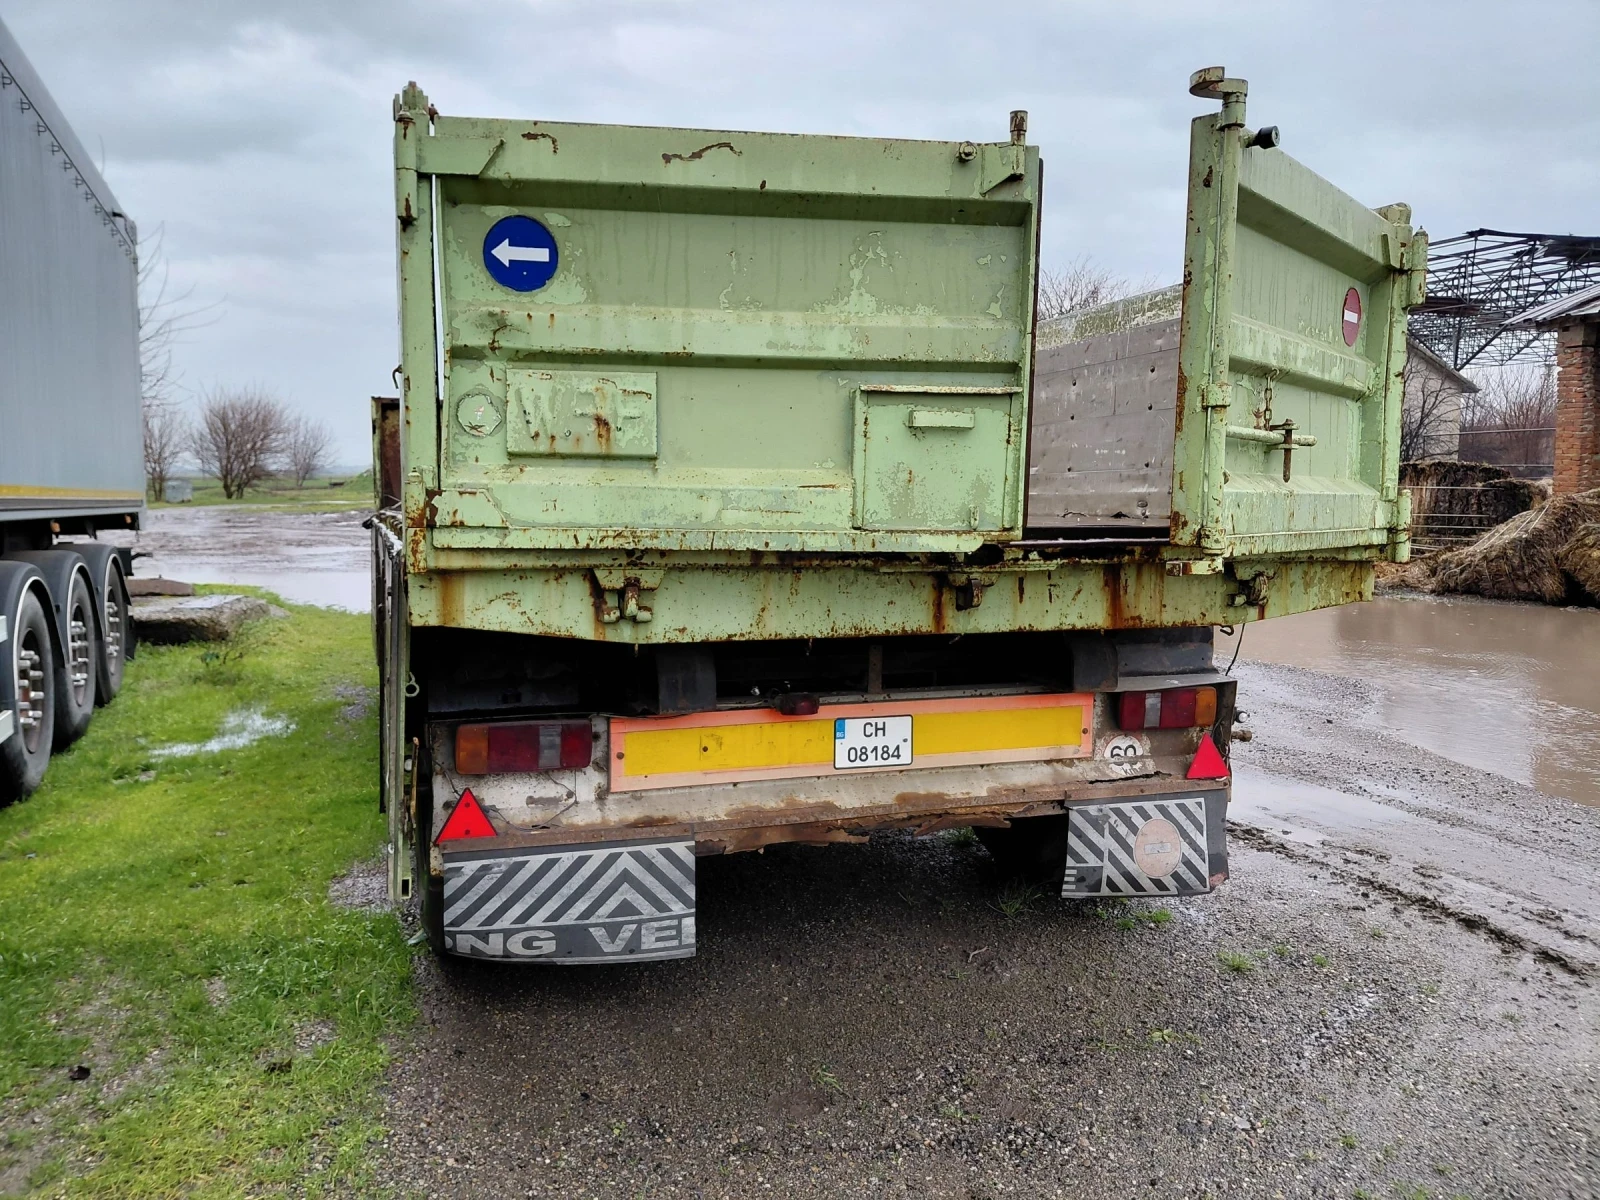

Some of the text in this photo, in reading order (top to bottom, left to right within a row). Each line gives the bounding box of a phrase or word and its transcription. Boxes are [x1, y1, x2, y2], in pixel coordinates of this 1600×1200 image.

[863, 721, 886, 738] CH
[847, 744, 902, 763] 08184
[445, 929, 557, 956] NG
